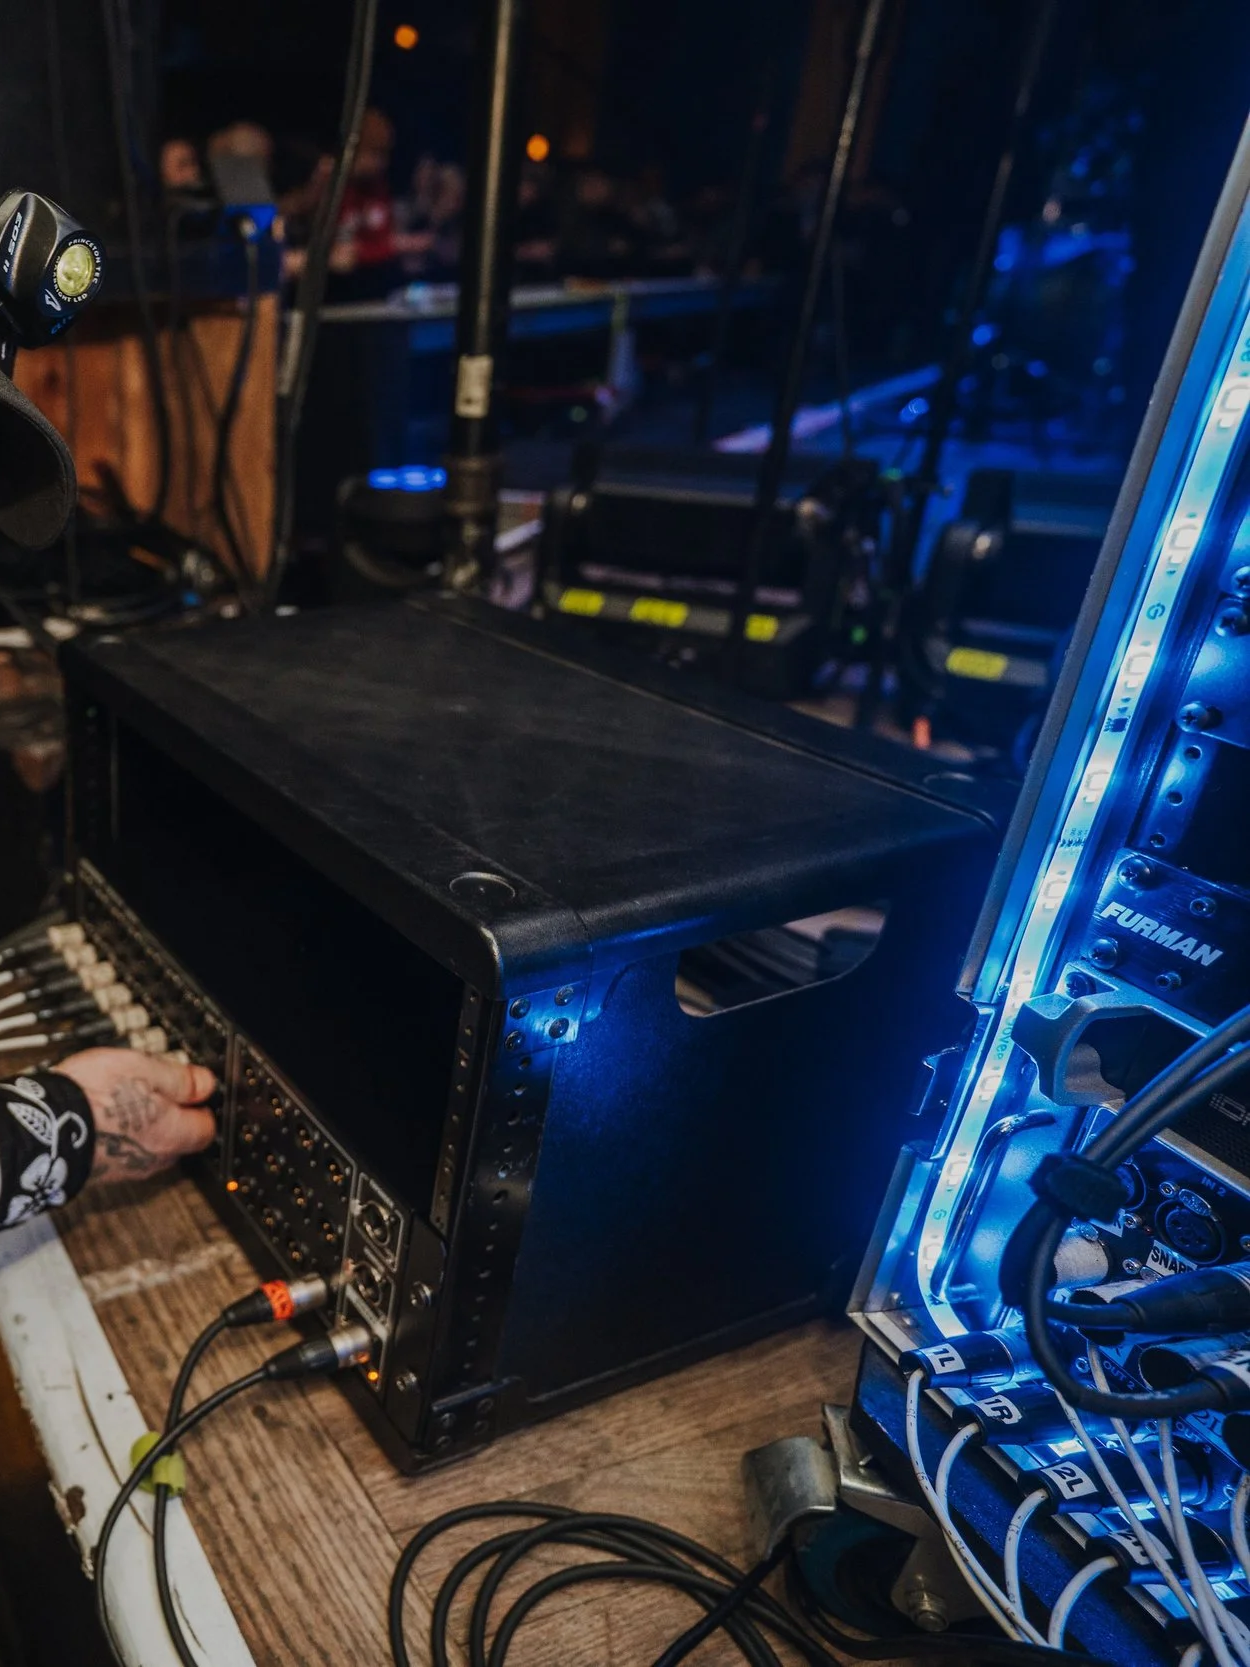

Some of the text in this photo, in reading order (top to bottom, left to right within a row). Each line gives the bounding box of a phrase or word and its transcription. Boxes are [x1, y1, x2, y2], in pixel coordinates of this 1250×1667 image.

[7, 212, 23, 256] EOS
[68, 238, 101, 284] PRINCETON TEC
[73, 293, 88, 303] LED
[1099, 901, 1224, 967] FURMAN
[1200, 1176, 1227, 1198] IN 2
[932, 1347, 955, 1368] 1L
[1103, 1360, 1135, 1390] OUT 2
[984, 1398, 1014, 1421] 1R
[1176, 1421, 1201, 1444] OUT
[1051, 1466, 1084, 1493] 2L
